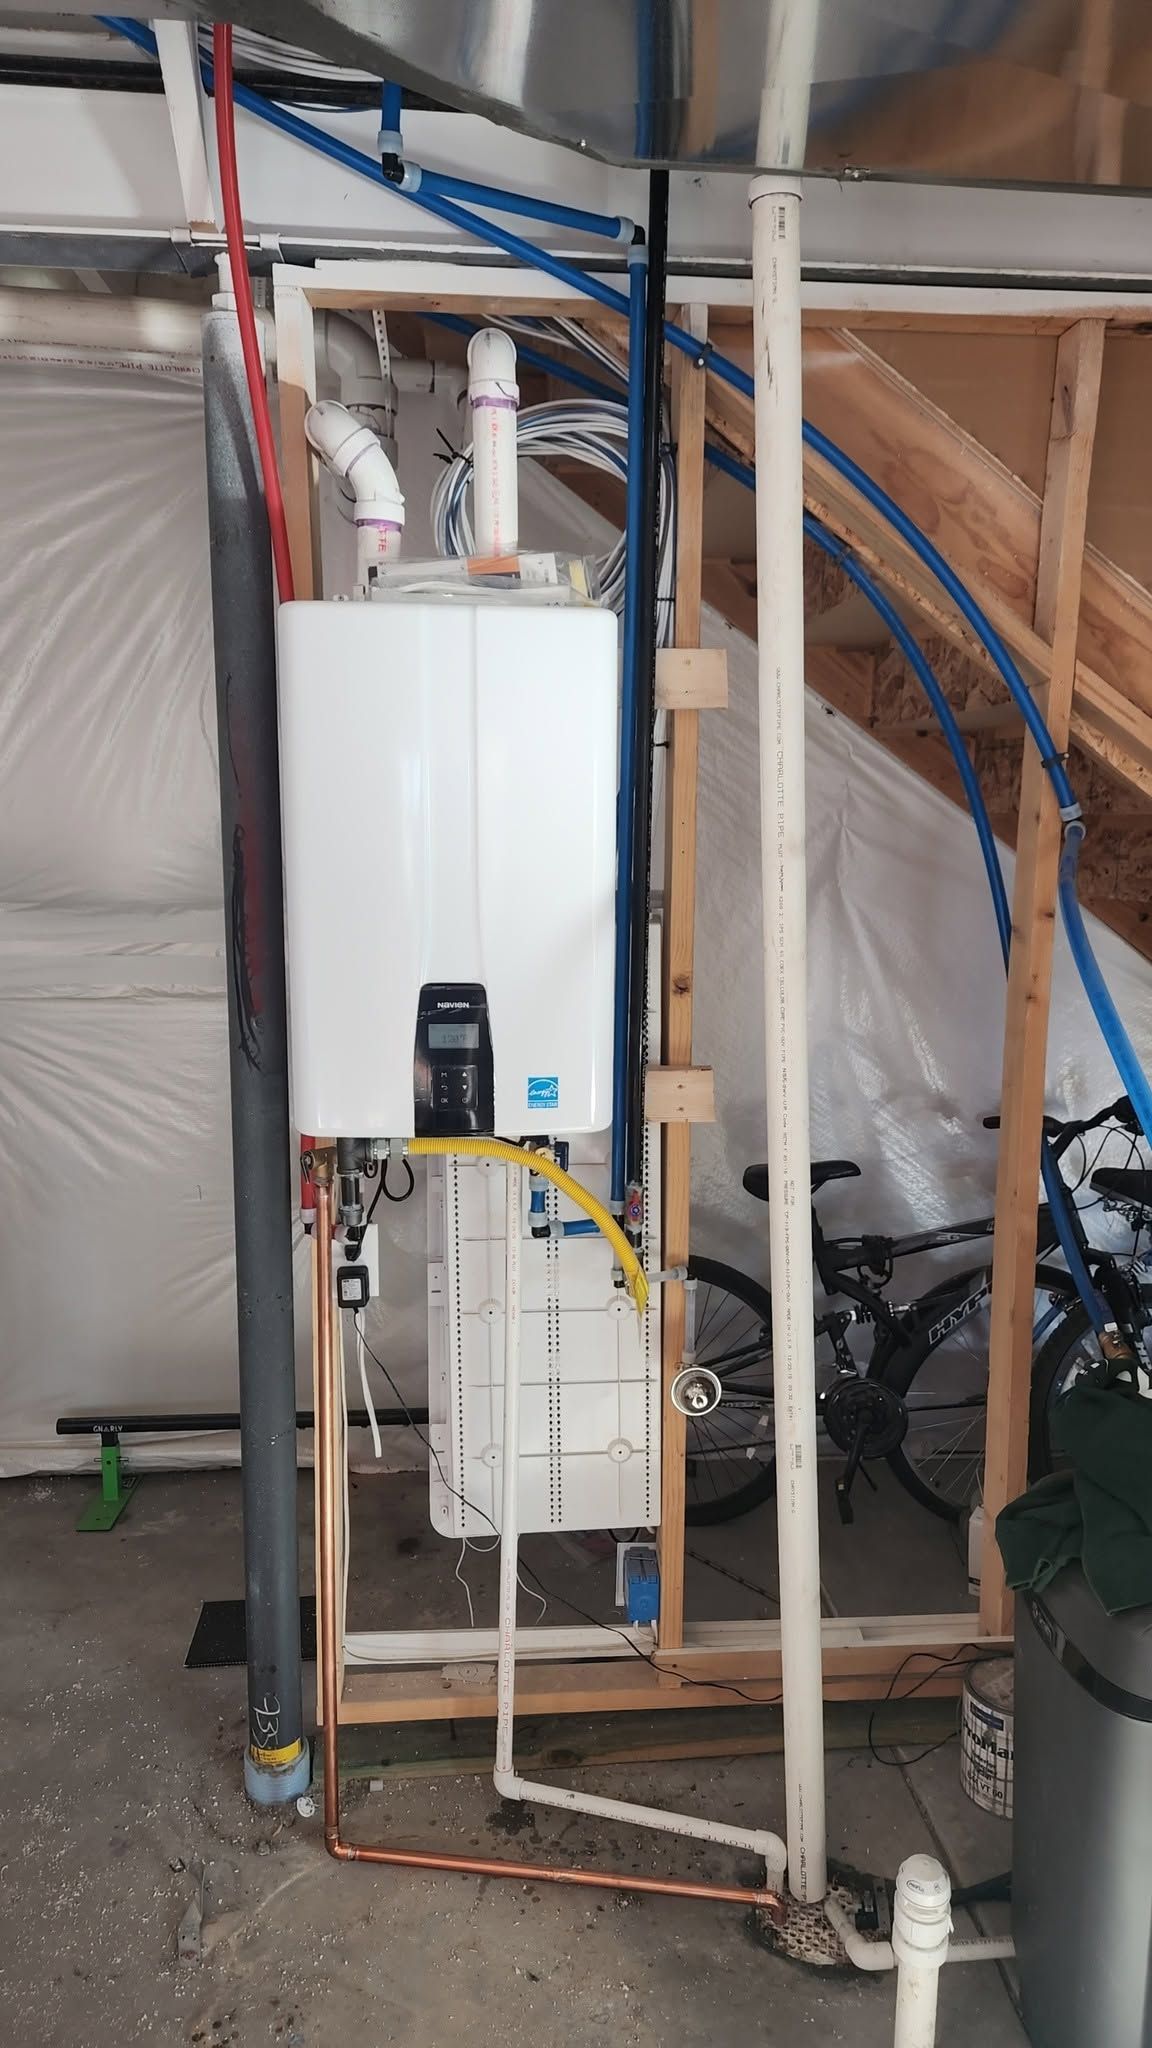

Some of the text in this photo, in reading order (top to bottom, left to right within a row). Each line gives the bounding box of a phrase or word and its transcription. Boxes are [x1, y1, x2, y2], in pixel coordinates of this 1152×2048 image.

[776, 750, 784, 806] CHARLOTTE
[777, 813, 785, 838] PIPE
[928, 1280, 993, 1345] HYP
[92, 1424, 123, 1433] GNARLY
[503, 1617, 512, 1695] CHARLOTTE
[962, 1716, 1013, 1760] ProMa
[799, 1847, 807, 1890] CHARLOTTE
